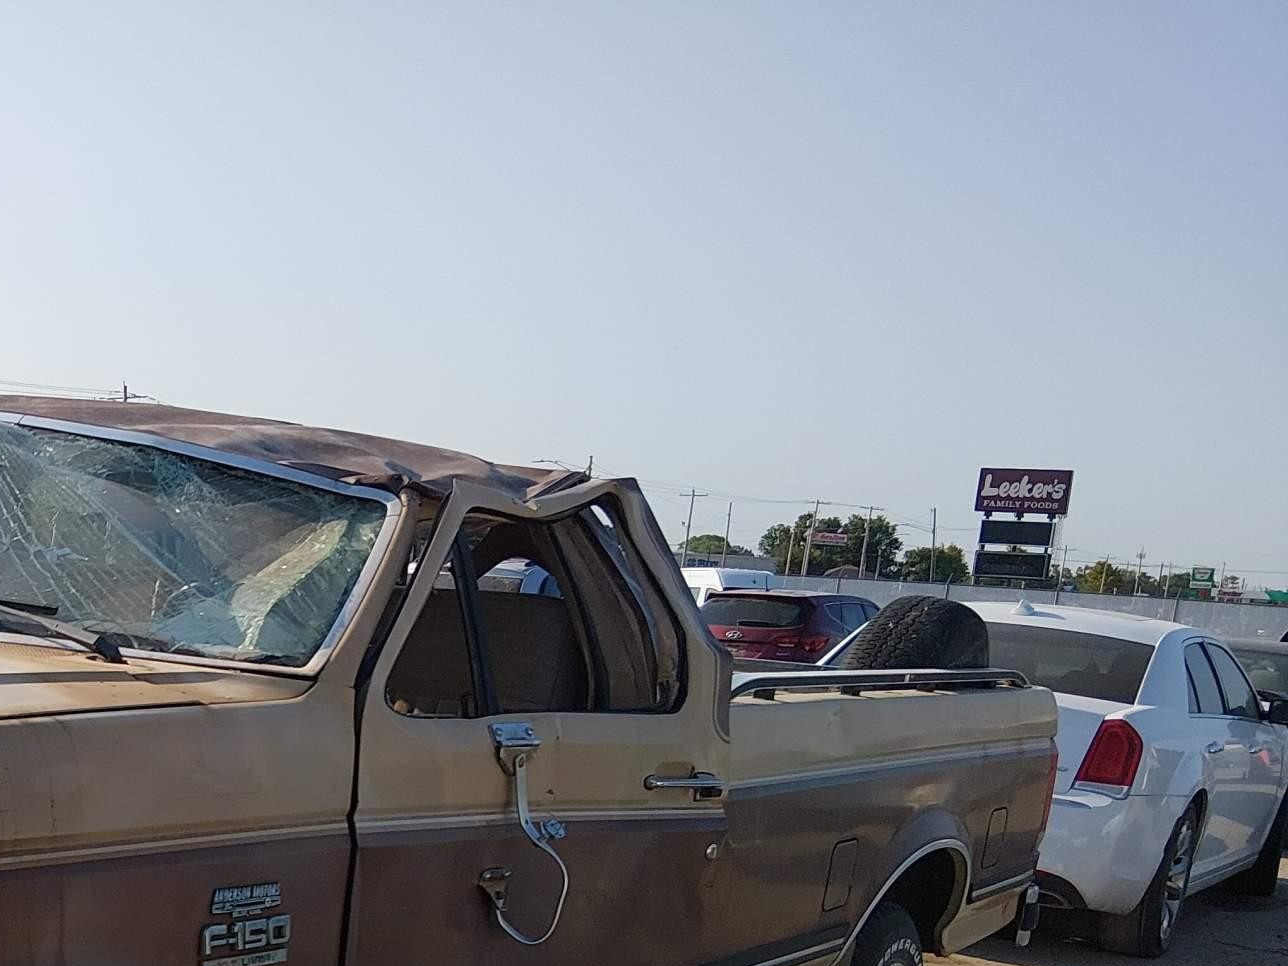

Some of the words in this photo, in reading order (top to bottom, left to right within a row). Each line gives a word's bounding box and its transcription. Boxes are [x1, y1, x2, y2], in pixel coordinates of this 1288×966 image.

[981, 473, 1066, 499] Leeker's
[983, 499, 1021, 508] FAMILY
[1024, 501, 1059, 510] FOODS
[204, 914, 290, 955] F-150
